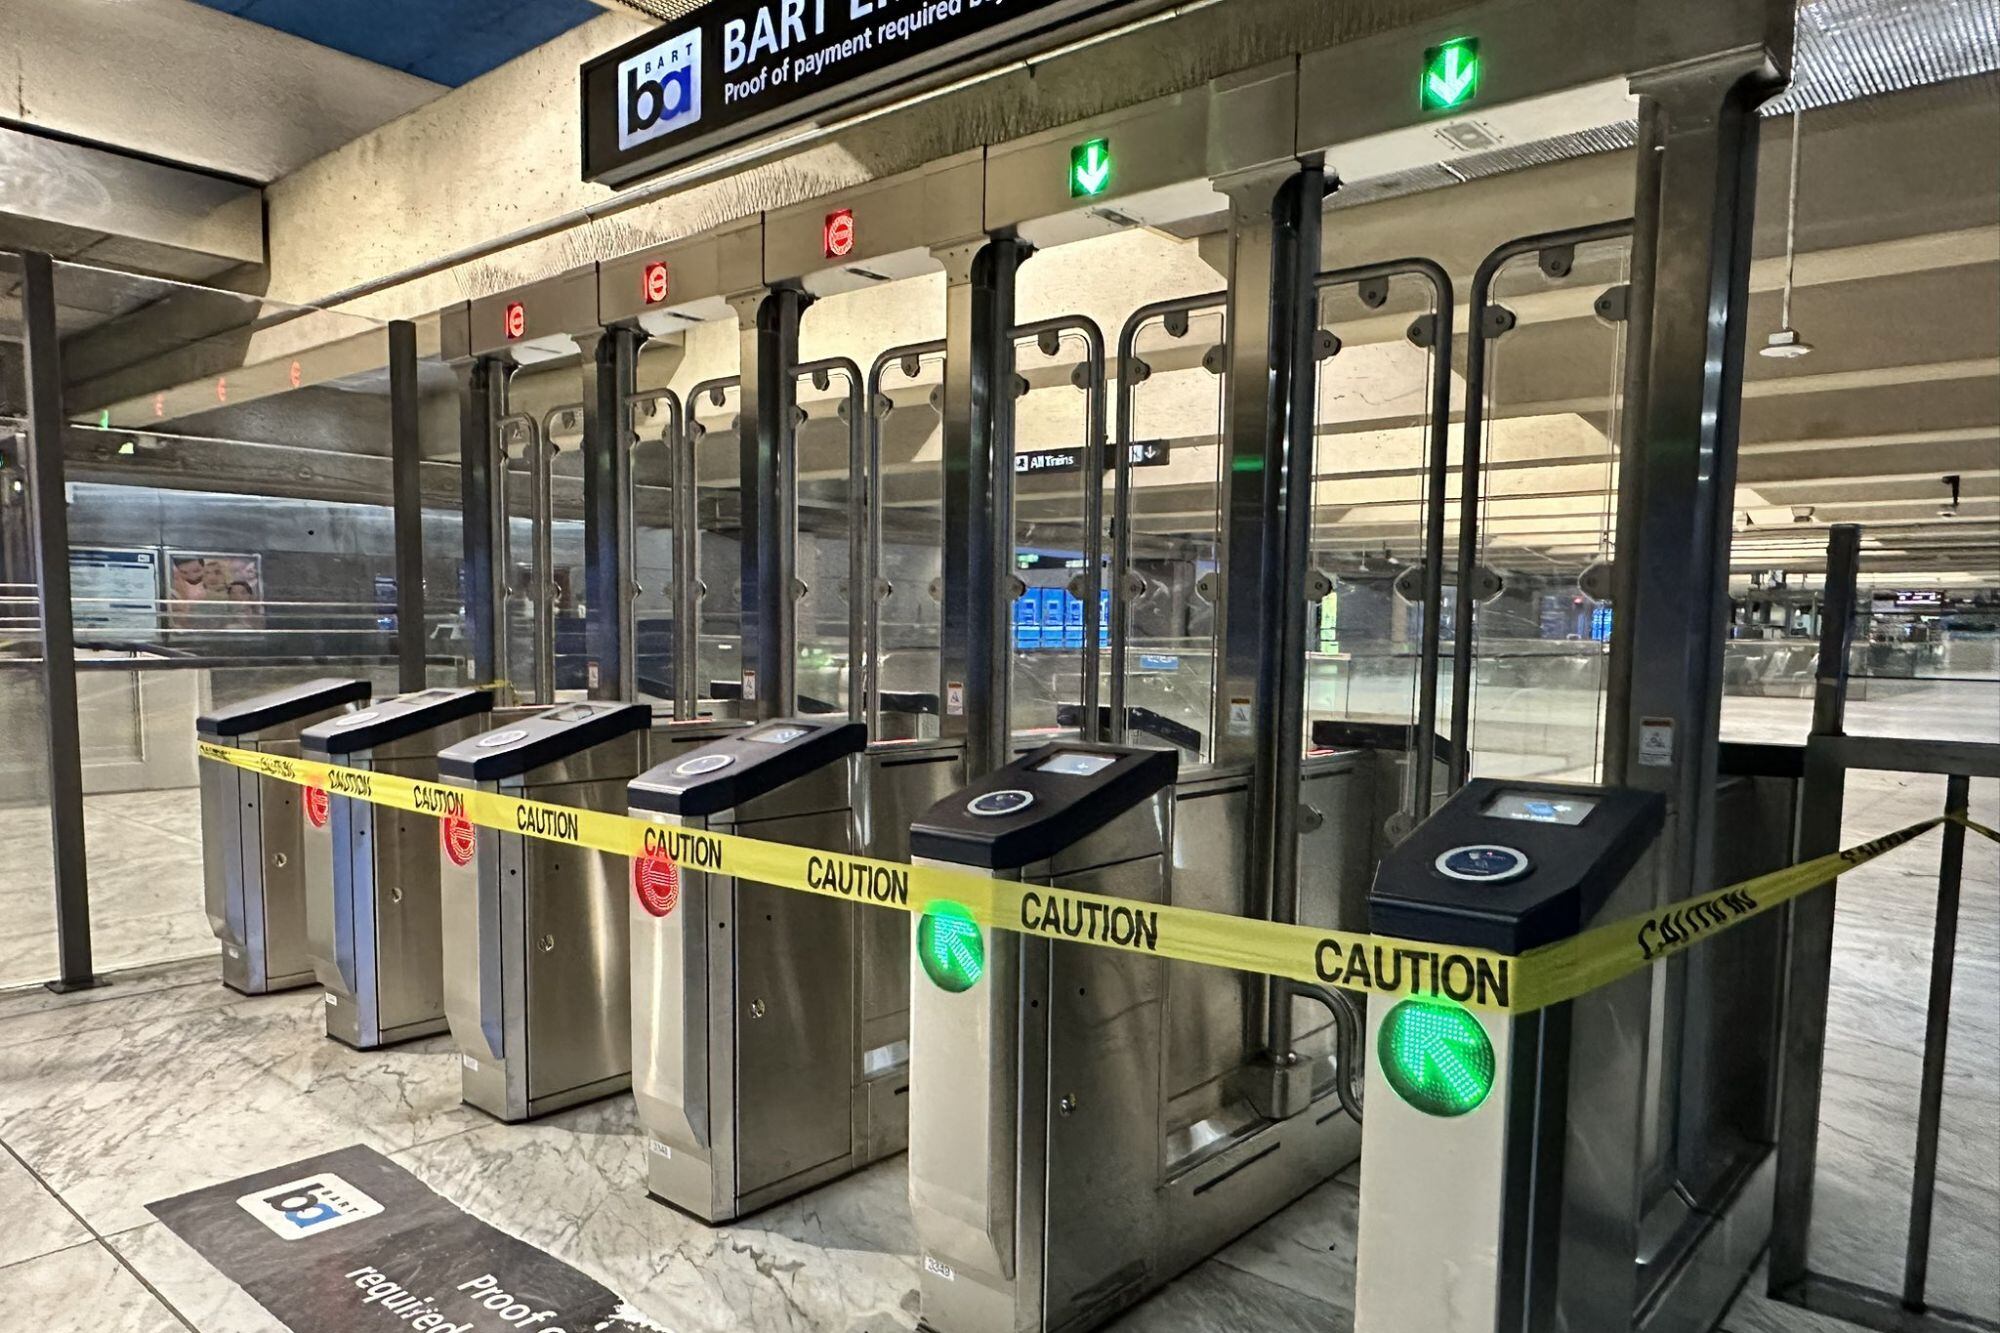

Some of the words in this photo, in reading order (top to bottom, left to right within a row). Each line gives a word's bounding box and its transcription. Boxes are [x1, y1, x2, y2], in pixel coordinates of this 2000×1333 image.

[644, 43, 693, 74] BART
[724, 0, 825, 73] BART
[725, 66, 768, 104] Proof
[771, 57, 789, 86] of
[795, 27, 873, 82] payment
[878, 0, 961, 44] required
[1031, 455, 1044, 468] All
[1045, 454, 1074, 466] Trains
[328, 769, 372, 797] CAUTION
[413, 785, 464, 817] CAUTION
[516, 803, 579, 841] CAUTION
[644, 827, 722, 869] CAUTION
[807, 855, 909, 905] CAUTION
[1020, 891, 1157, 951] CAUTION
[1315, 938, 1509, 1008] CAUTION
[344, 1265, 473, 1333] required
[457, 1273, 557, 1328] Proof
